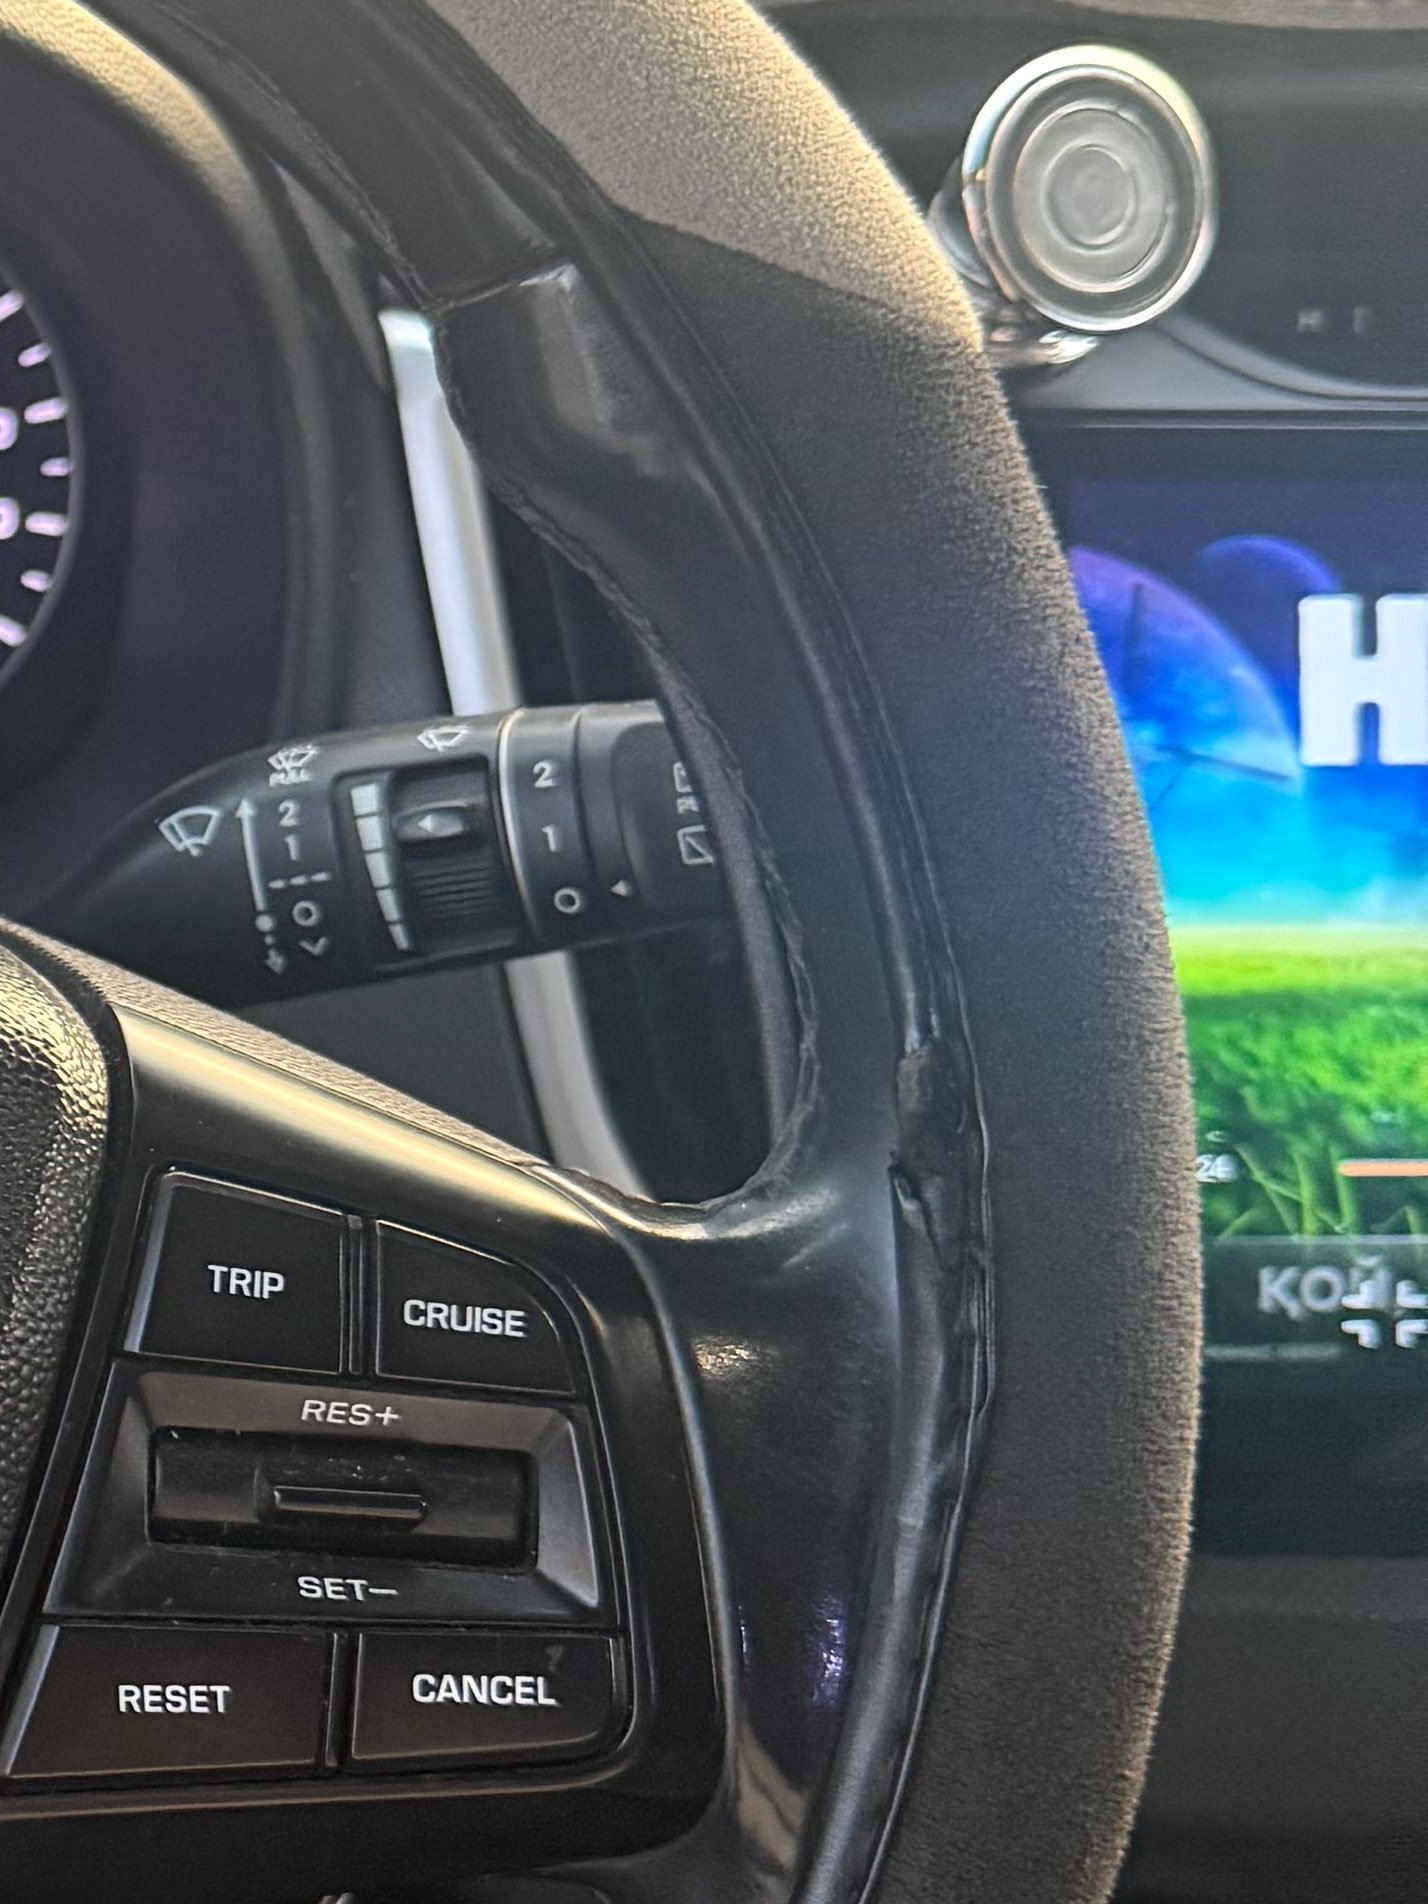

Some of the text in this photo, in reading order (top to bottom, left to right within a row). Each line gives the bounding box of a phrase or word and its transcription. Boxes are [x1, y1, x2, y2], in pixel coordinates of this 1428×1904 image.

[533, 761, 555, 788] 2
[278, 799, 300, 827] 2
[284, 834, 300, 861] 1
[542, 826, 561, 851] 1
[207, 1263, 285, 1298] TRIP
[403, 1299, 528, 1337] CRUISE
[301, 1399, 400, 1426] RES+
[118, 1683, 231, 1714] RESET
[411, 1673, 559, 1707] CANCEL
